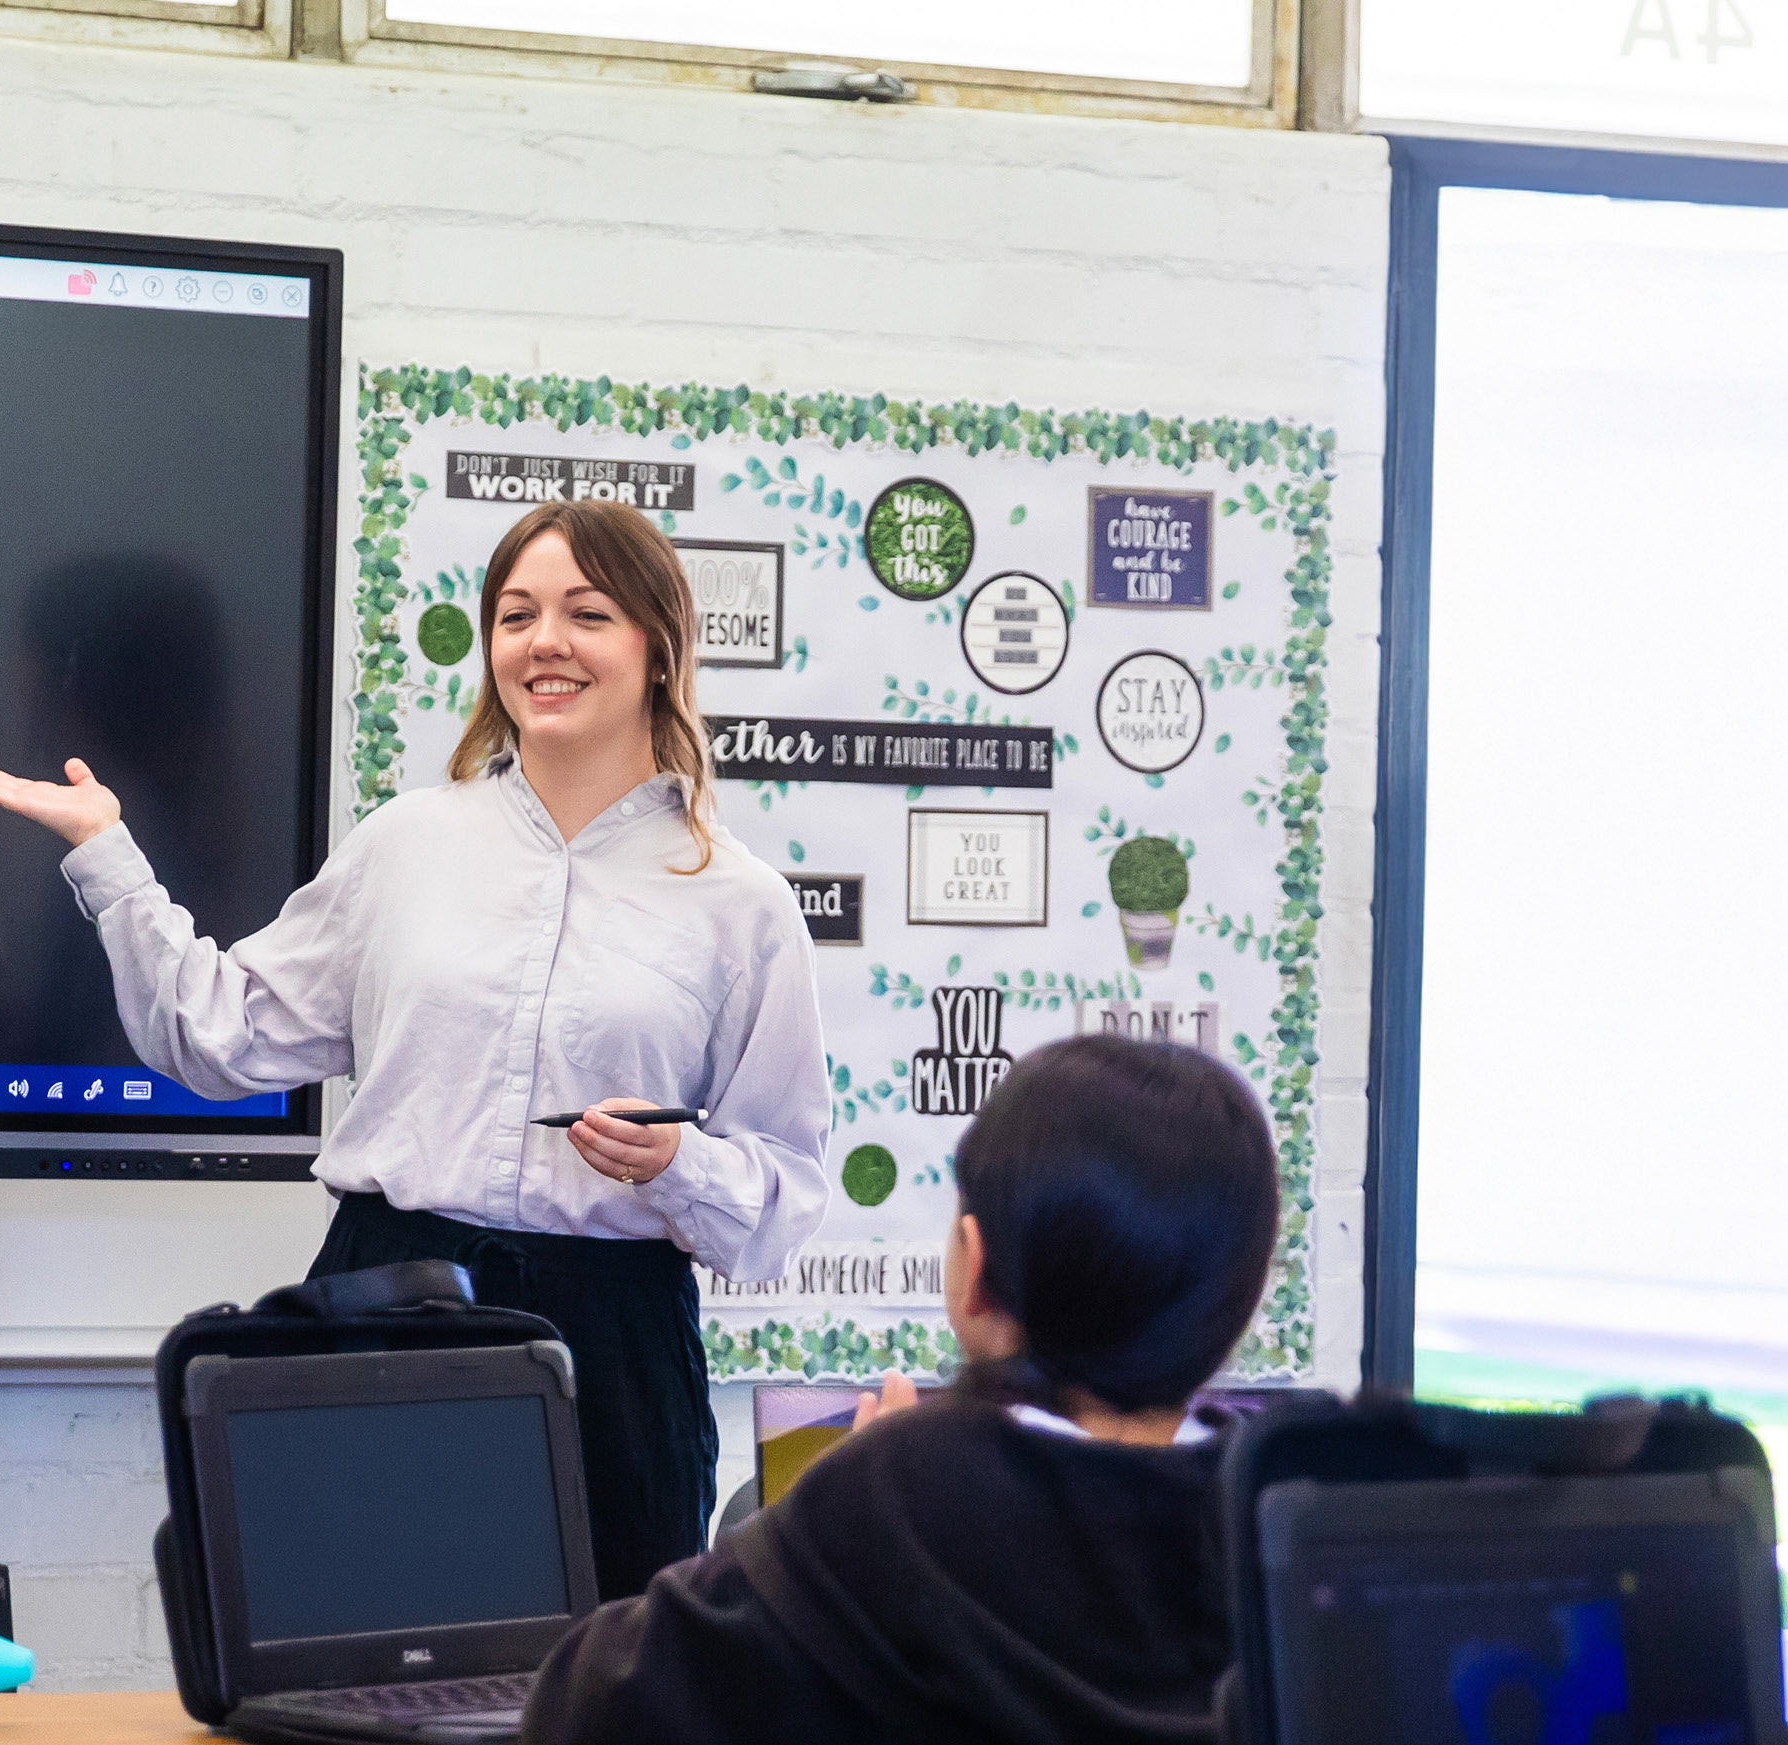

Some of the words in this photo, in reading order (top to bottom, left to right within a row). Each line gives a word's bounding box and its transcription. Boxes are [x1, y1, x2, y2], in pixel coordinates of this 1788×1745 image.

[455, 455, 510, 477] DON'T
[521, 458, 562, 479] JUST
[572, 461, 618, 481] WISH
[628, 464, 659, 484] FOR
[669, 466, 687, 485] IT
[468, 474, 566, 502] WORK
[572, 480, 637, 506] FOR
[645, 483, 674, 508] IT
[893, 494, 948, 523] you
[901, 524, 942, 553] GOT
[1107, 519, 1192, 551] COURAGE
[888, 553, 949, 585] this
[1112, 550, 1155, 572] and
[1160, 550, 1186, 574] be
[1127, 571, 1172, 602] KIND
[1117, 678, 1186, 713] STAY
[709, 720, 826, 764] ether
[831, 734, 847, 767] IS
[854, 735, 877, 768] MY
[883, 736, 950, 769] FAVORITE
[956, 738, 999, 771] PLACE
[1005, 739, 1023, 771] TO
[1028, 740, 1048, 773] BE
[961, 833, 1000, 852] YOU
[954, 857, 1006, 876] LOOK
[943, 881, 1011, 900] GREAT
[936, 988, 998, 1056] YOU
[799, 1254, 889, 1295] SOMEONE
